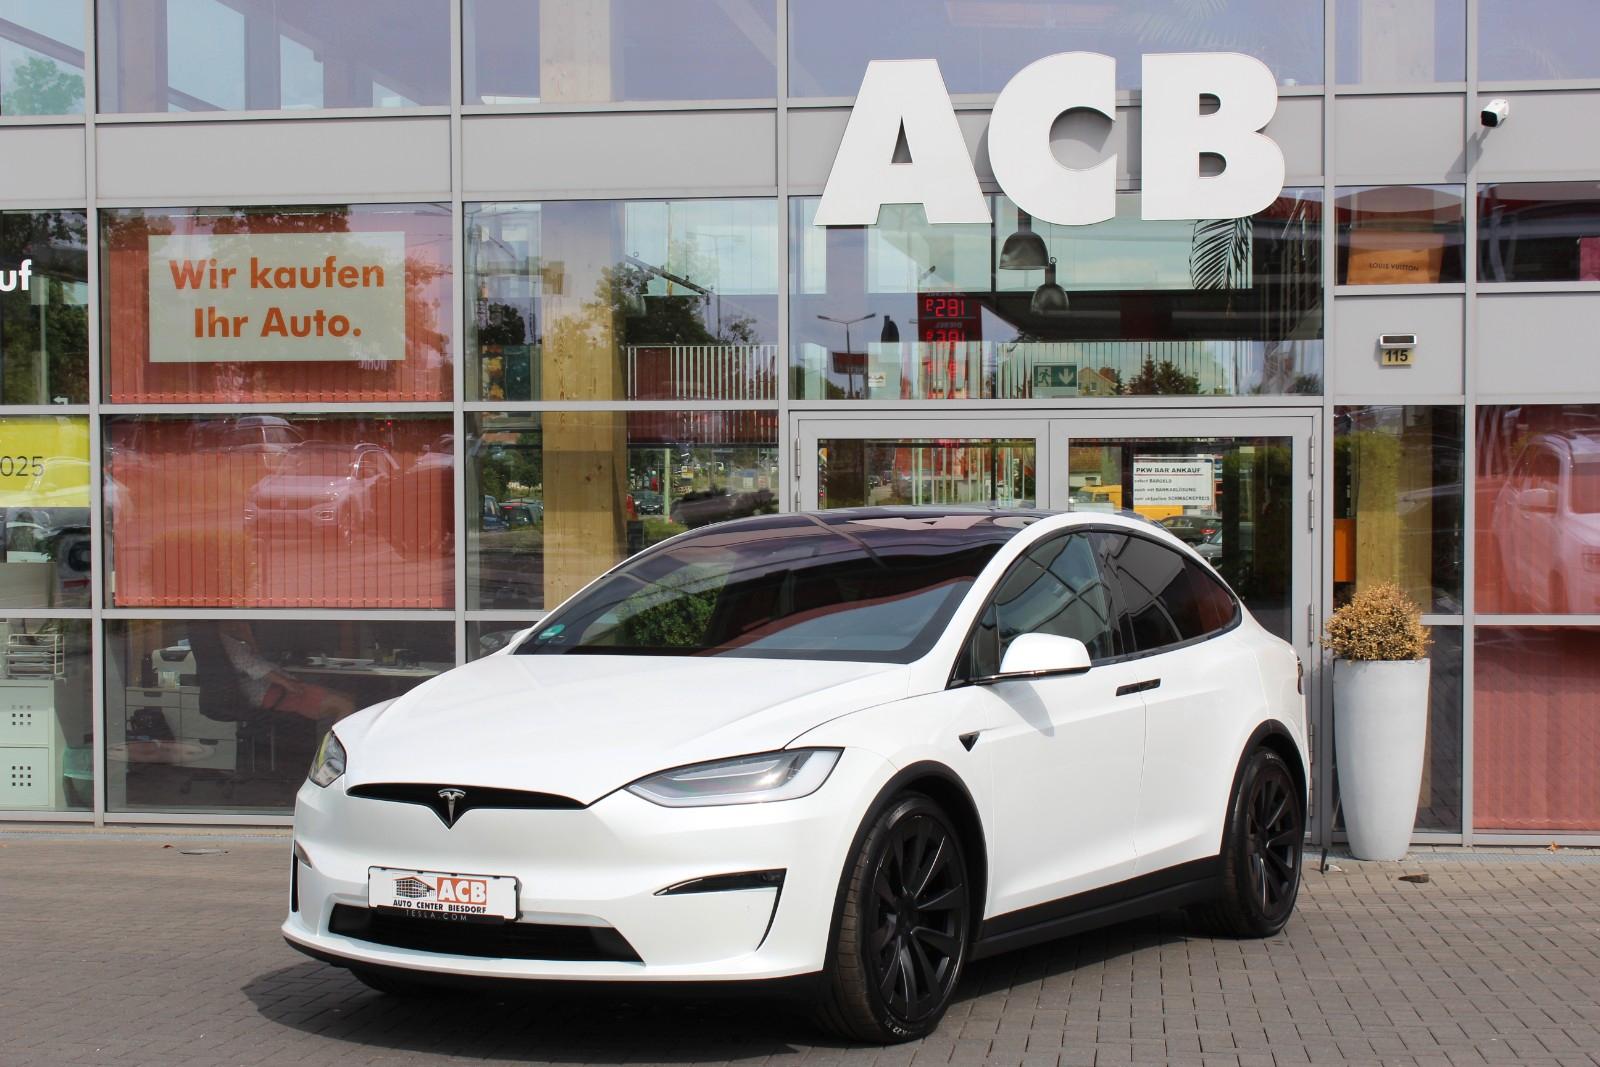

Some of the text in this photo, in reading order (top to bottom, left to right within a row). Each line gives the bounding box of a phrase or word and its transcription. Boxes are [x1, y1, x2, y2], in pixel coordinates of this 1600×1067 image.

[813, 51, 1285, 226] ACB
[169, 255, 385, 290] Wir kaufen
[193, 306, 362, 338] Ihr Auto.
[1385, 349, 1409, 362] 115
[438, 879, 486, 903] ACB
[392, 899, 487, 914] AUTO CENTER BIESDORF
[405, 909, 468, 921] TESLA.COM
